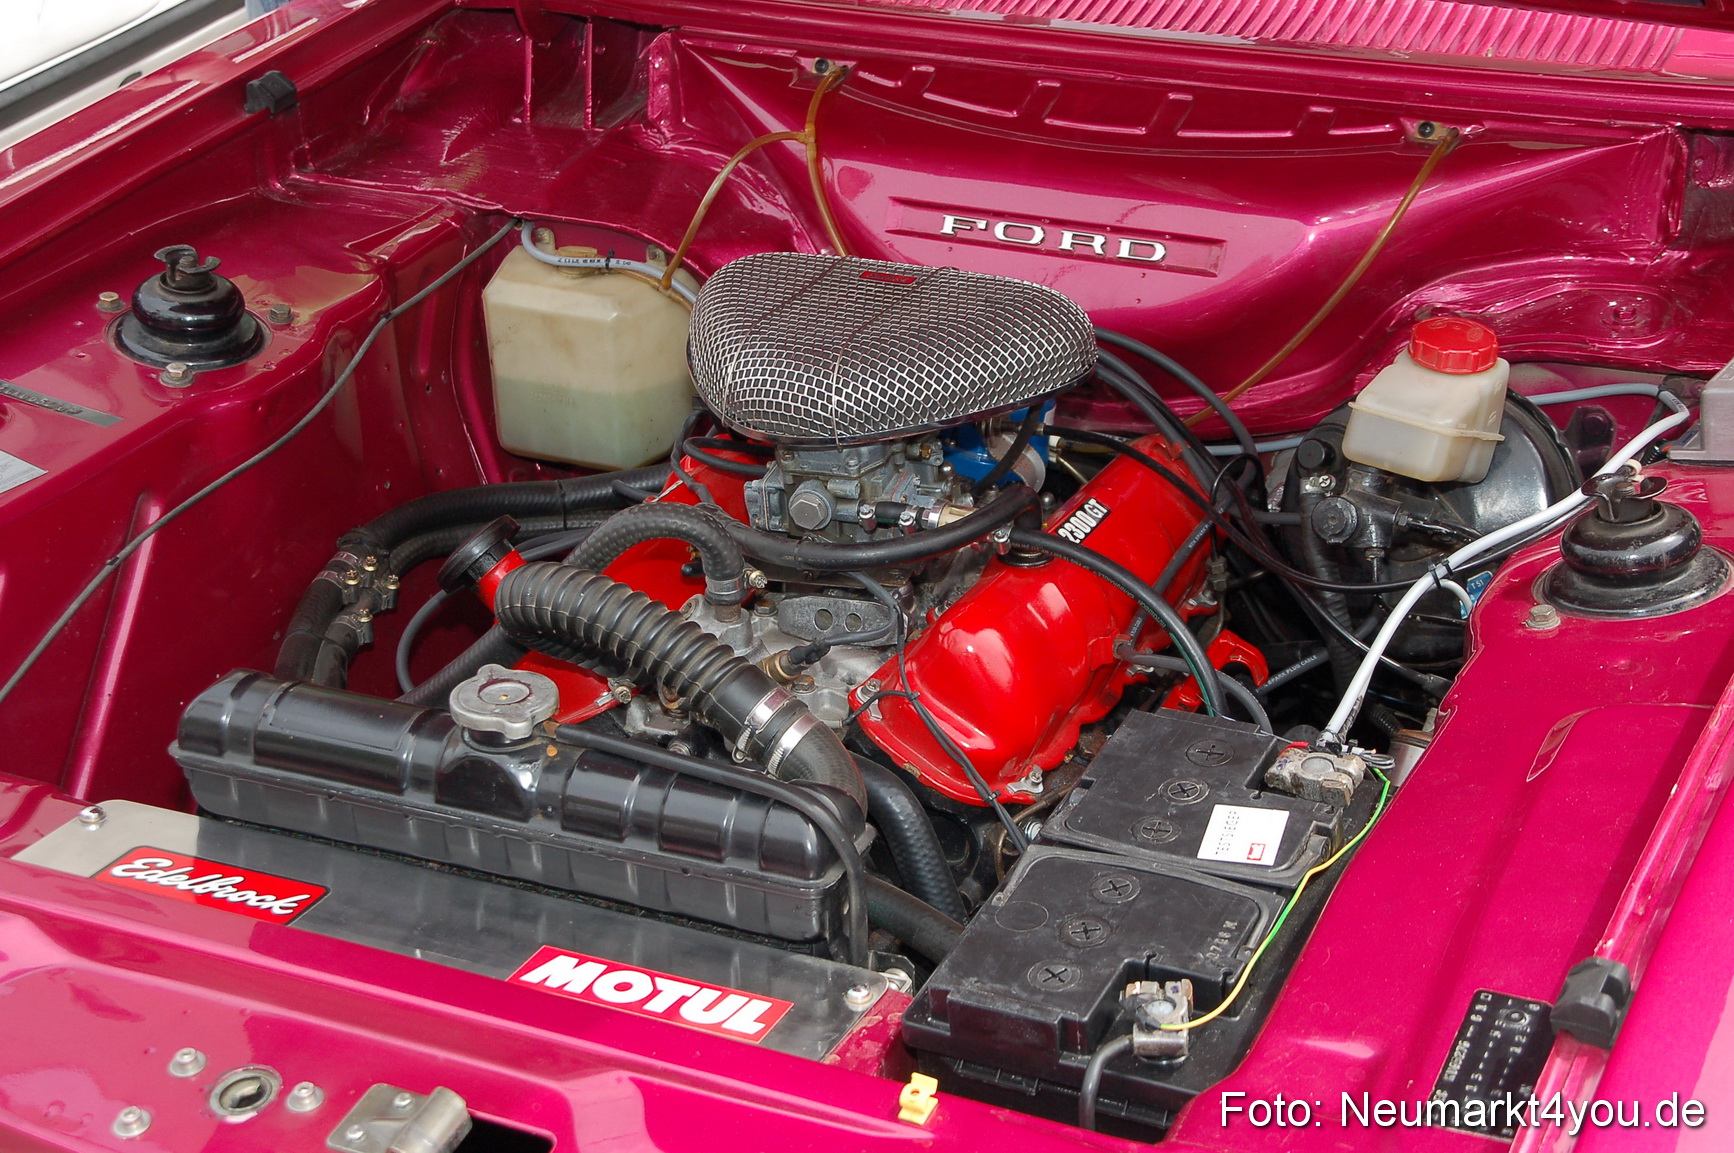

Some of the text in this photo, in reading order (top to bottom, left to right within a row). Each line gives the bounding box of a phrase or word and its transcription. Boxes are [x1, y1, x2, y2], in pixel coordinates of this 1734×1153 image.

[940, 214, 1167, 262] FORD
[110, 858, 311, 915] Edelbrock
[519, 954, 773, 1035] MOTUL
